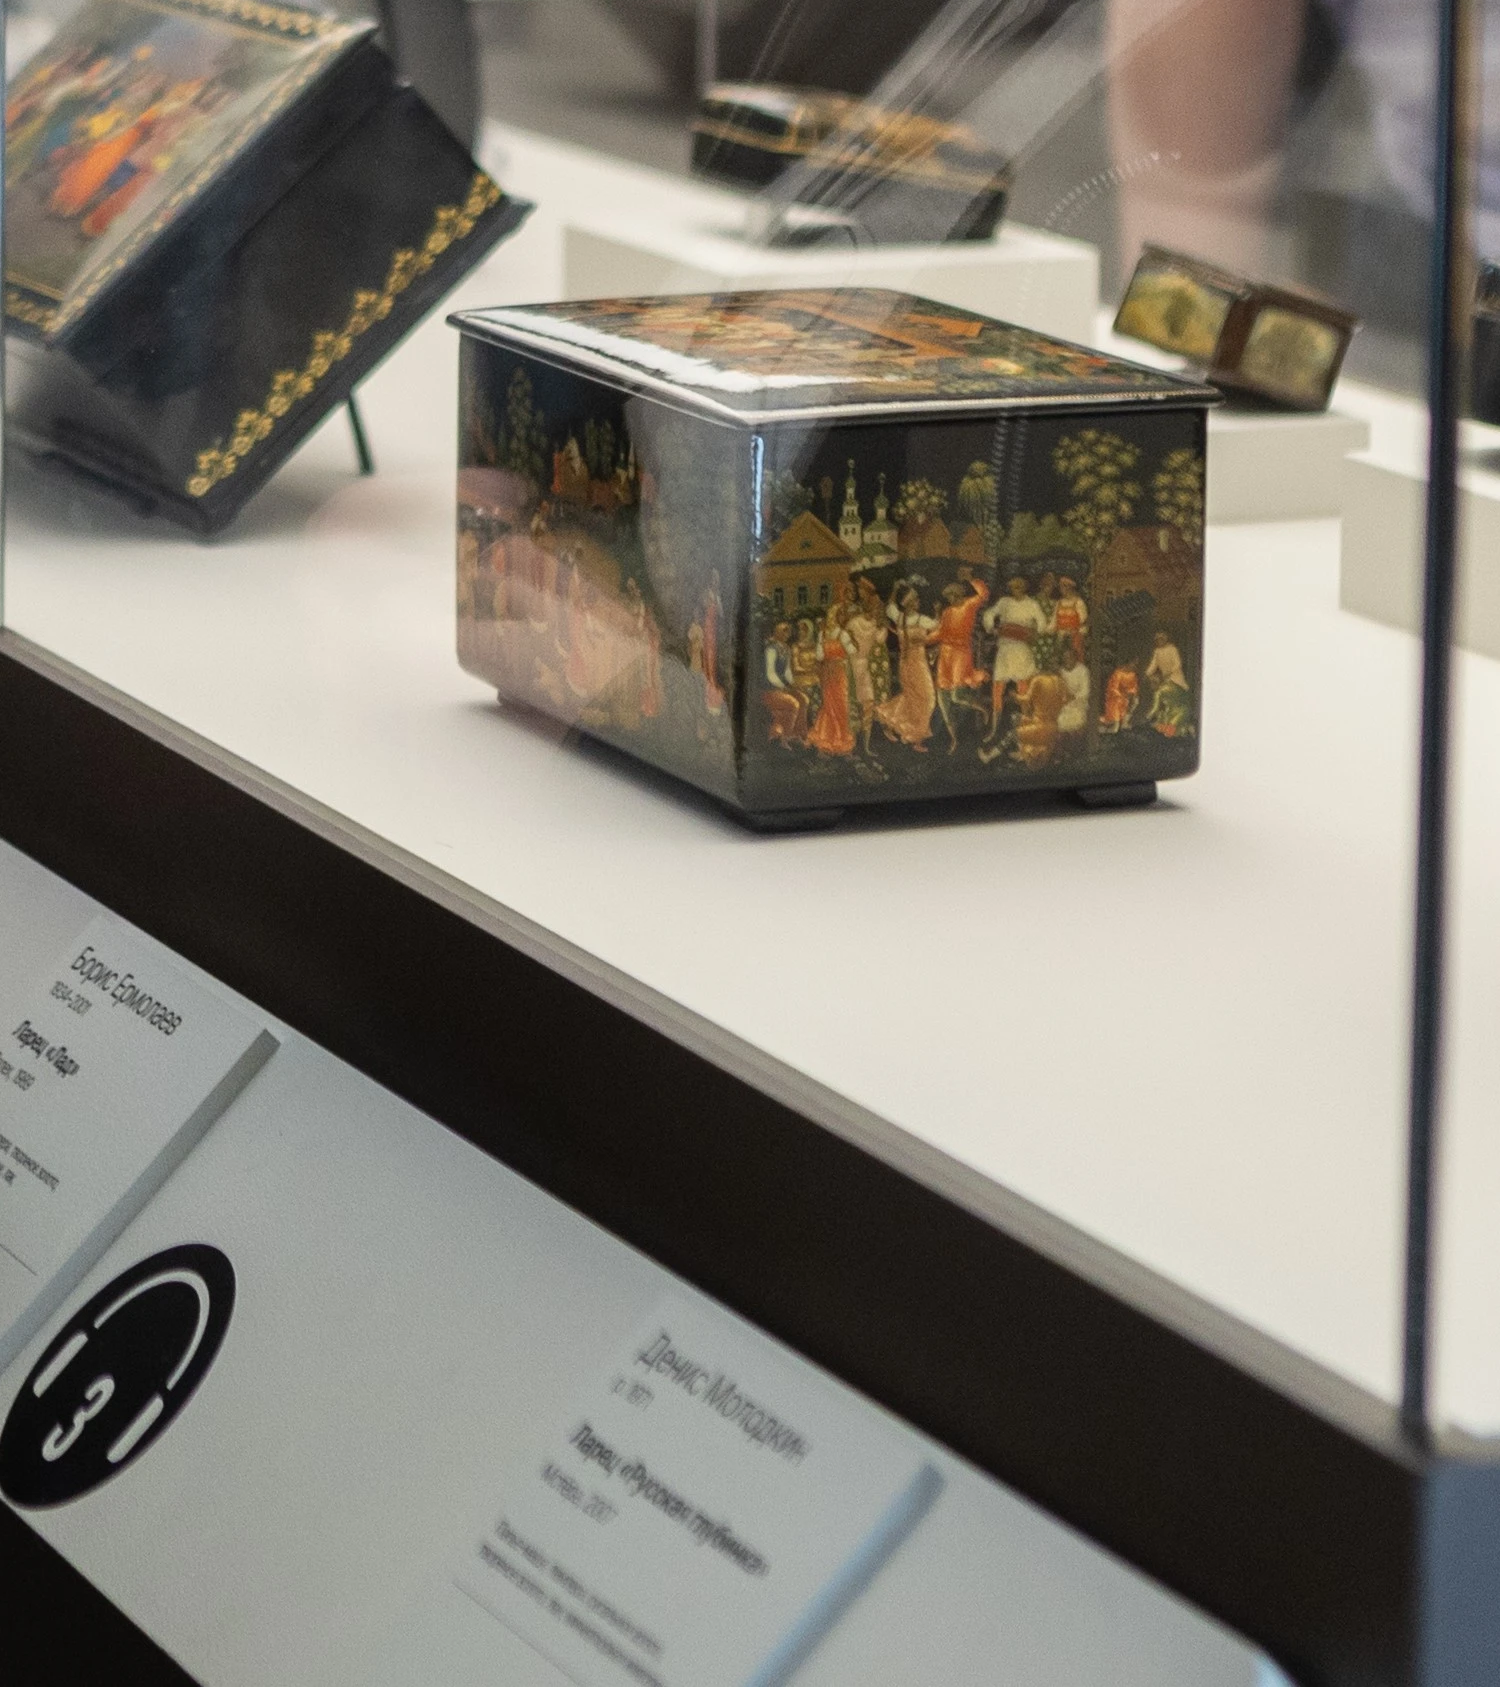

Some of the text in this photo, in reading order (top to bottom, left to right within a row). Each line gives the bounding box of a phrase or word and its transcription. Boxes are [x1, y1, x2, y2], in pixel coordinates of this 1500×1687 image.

[71, 946, 182, 1036] Борис Ермолаев
[12, 1020, 49, 1059] Ларец
[42, 1373, 115, 1461] 3
[638, 1332, 809, 1463] Денис Молодкин
[569, 1421, 621, 1476] Ларец
